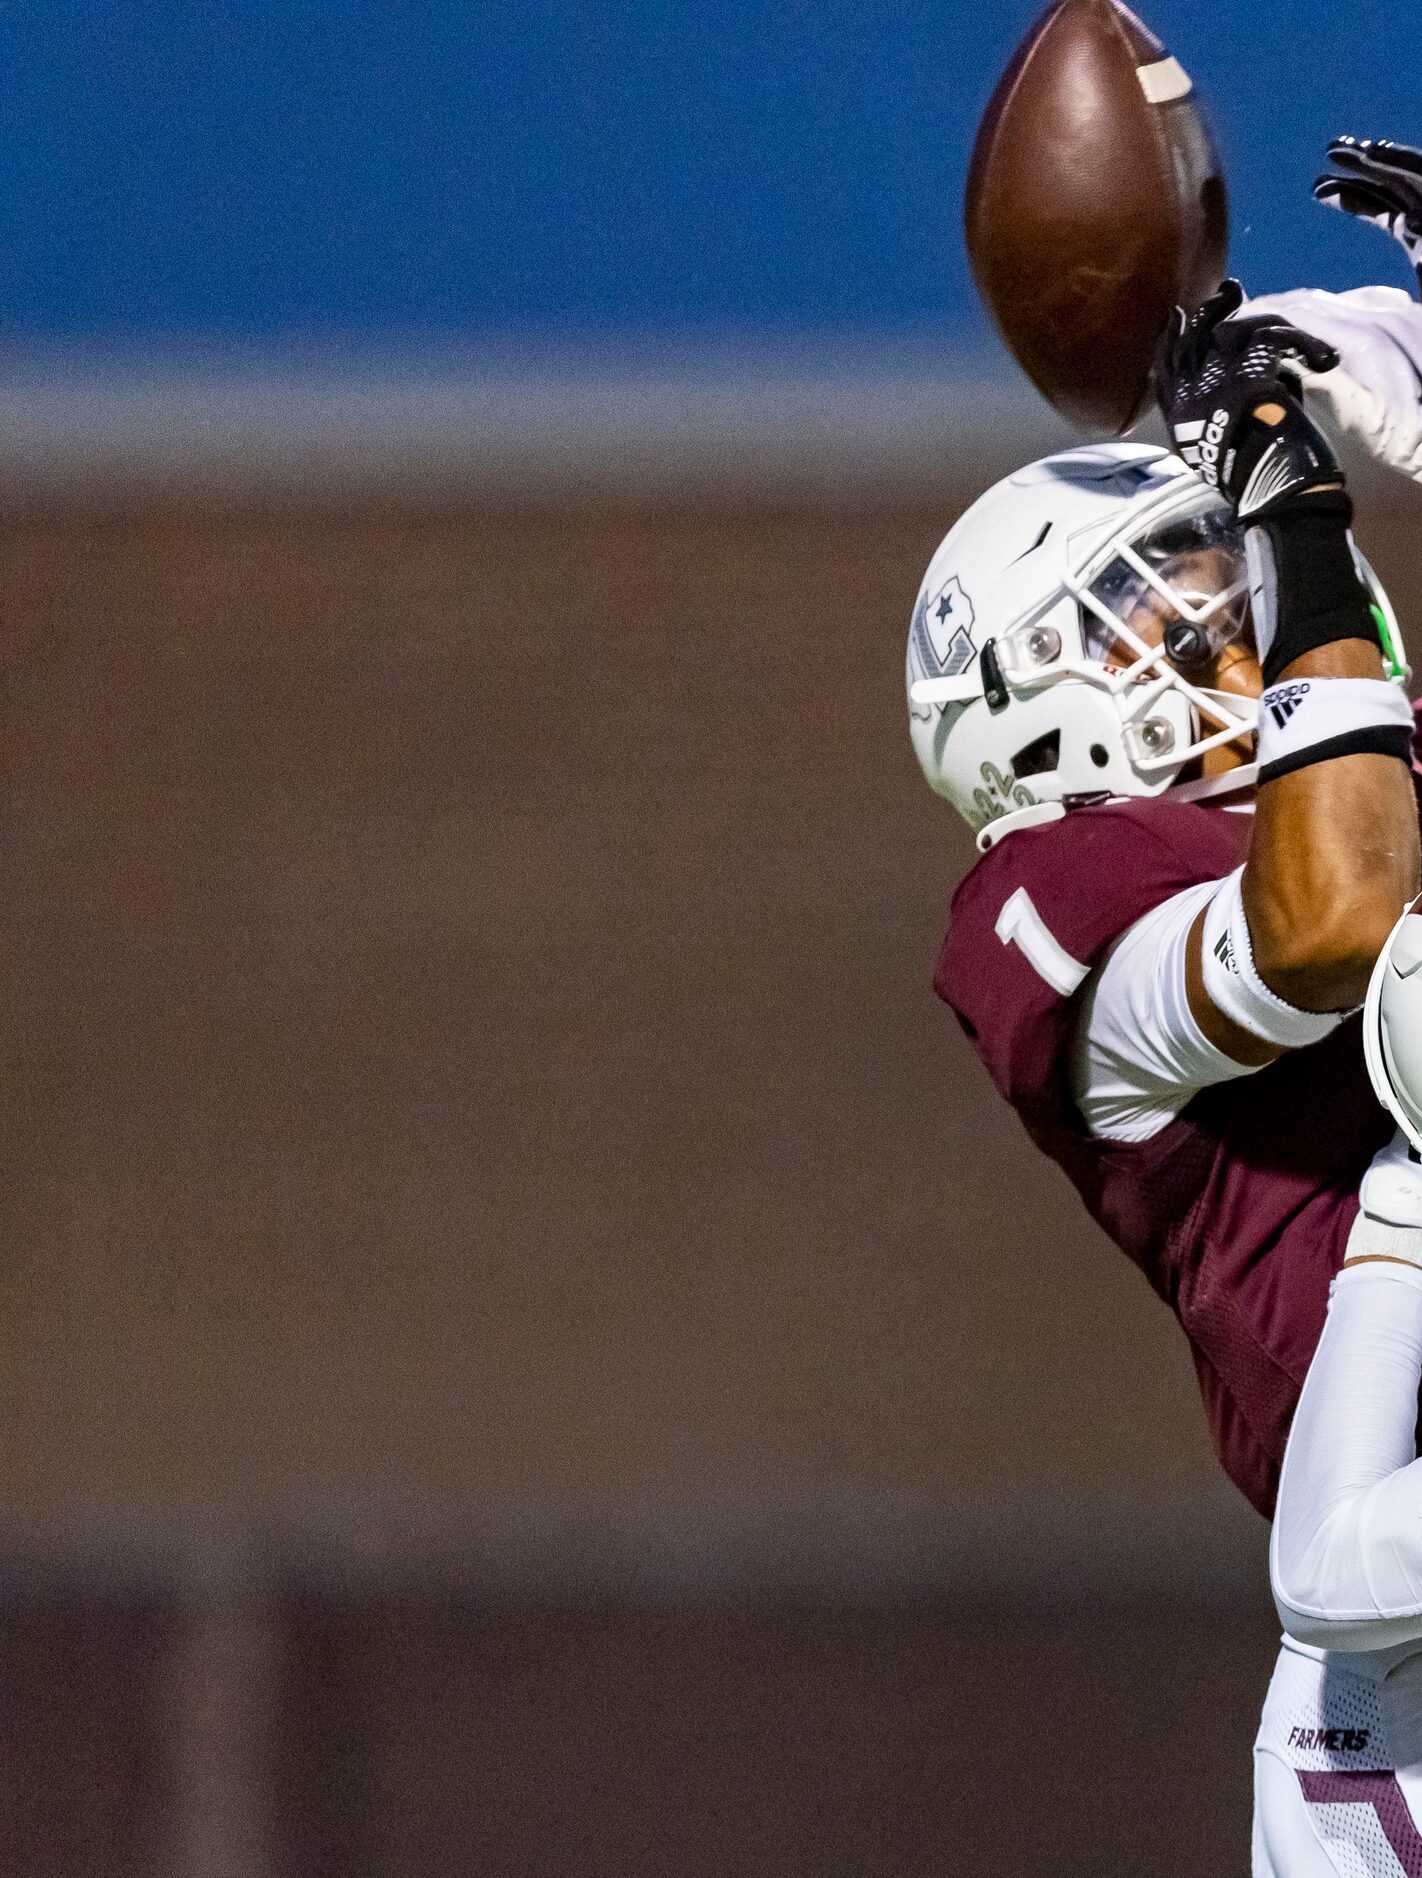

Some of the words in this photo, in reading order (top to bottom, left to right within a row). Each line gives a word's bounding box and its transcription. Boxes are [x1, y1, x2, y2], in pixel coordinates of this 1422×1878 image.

[1199, 408, 1229, 488] didas
[994, 886, 1093, 998] 1
[1287, 1726, 1370, 1756] FARMERS
